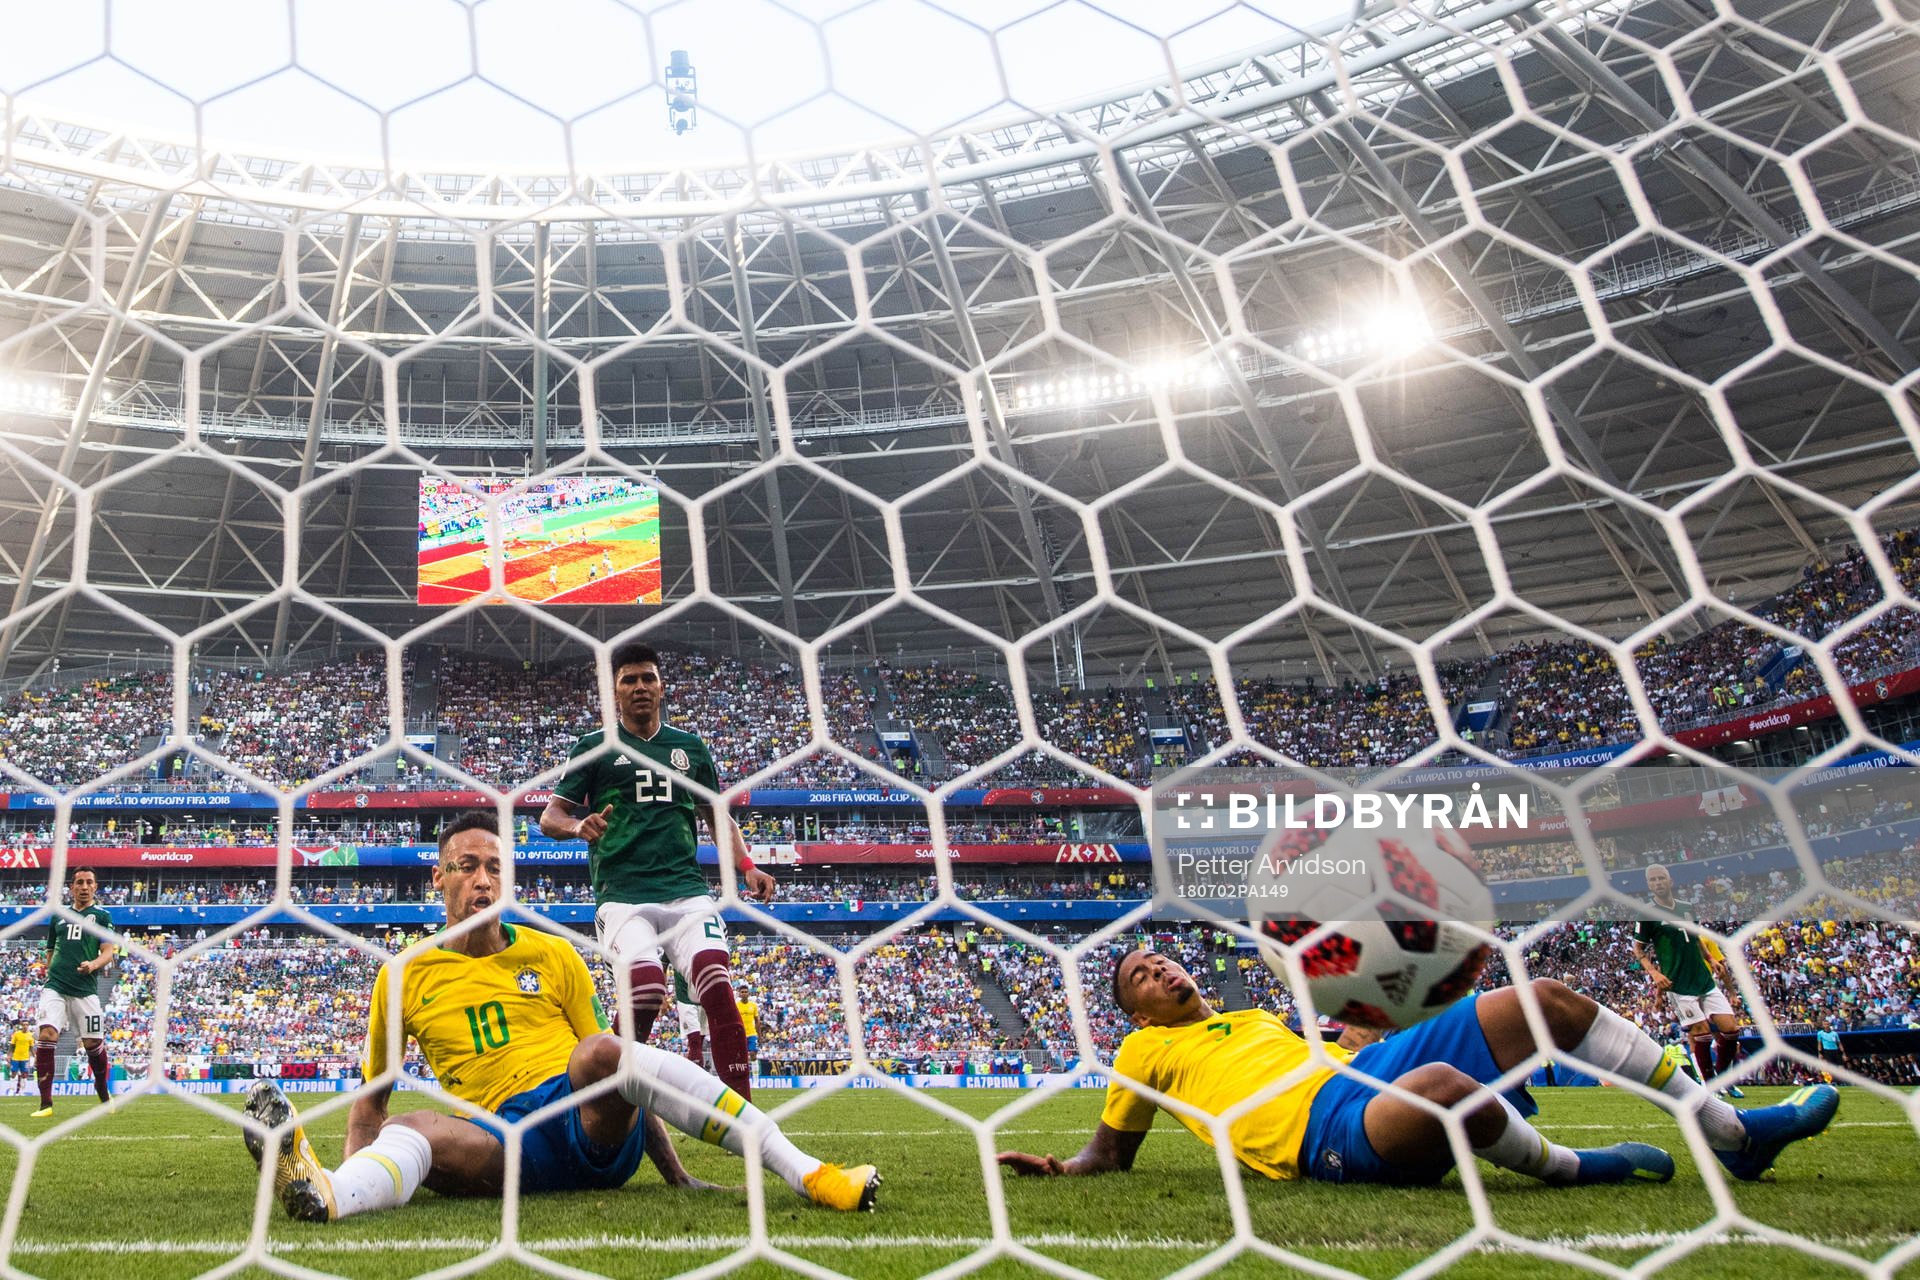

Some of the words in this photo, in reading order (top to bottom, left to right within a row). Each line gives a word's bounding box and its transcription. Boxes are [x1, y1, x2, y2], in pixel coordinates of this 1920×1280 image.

[1749, 713, 1790, 731] #worldcup
[1537, 759, 1560, 769] 2018
[1573, 752, 1613, 765] РОССИИ
[636, 770, 672, 803] 23
[124, 795, 138, 805] ПО
[140, 795, 185, 805] ФУТБОЛУ
[187, 795, 207, 805] FIFA
[208, 795, 230, 805] 2018
[809, 793, 831, 802] 2018
[832, 793, 853, 802] FIFA
[890, 793, 910, 802] CUP
[527, 851, 573, 859] ФУТБОЛУ
[575, 851, 589, 859] FIF
[1212, 845, 1250, 855] WORLD
[140, 851, 193, 863] #worldcup
[66, 923, 82, 940] 18
[85, 1015, 101, 1033] 18
[464, 1000, 510, 1055] 10
[728, 1063, 748, 1073] FMF
[173, 1081, 222, 1094] AZPROM
[283, 1081, 336, 1093] GAZPROM
[966, 1076, 1020, 1088] GAZPROM
